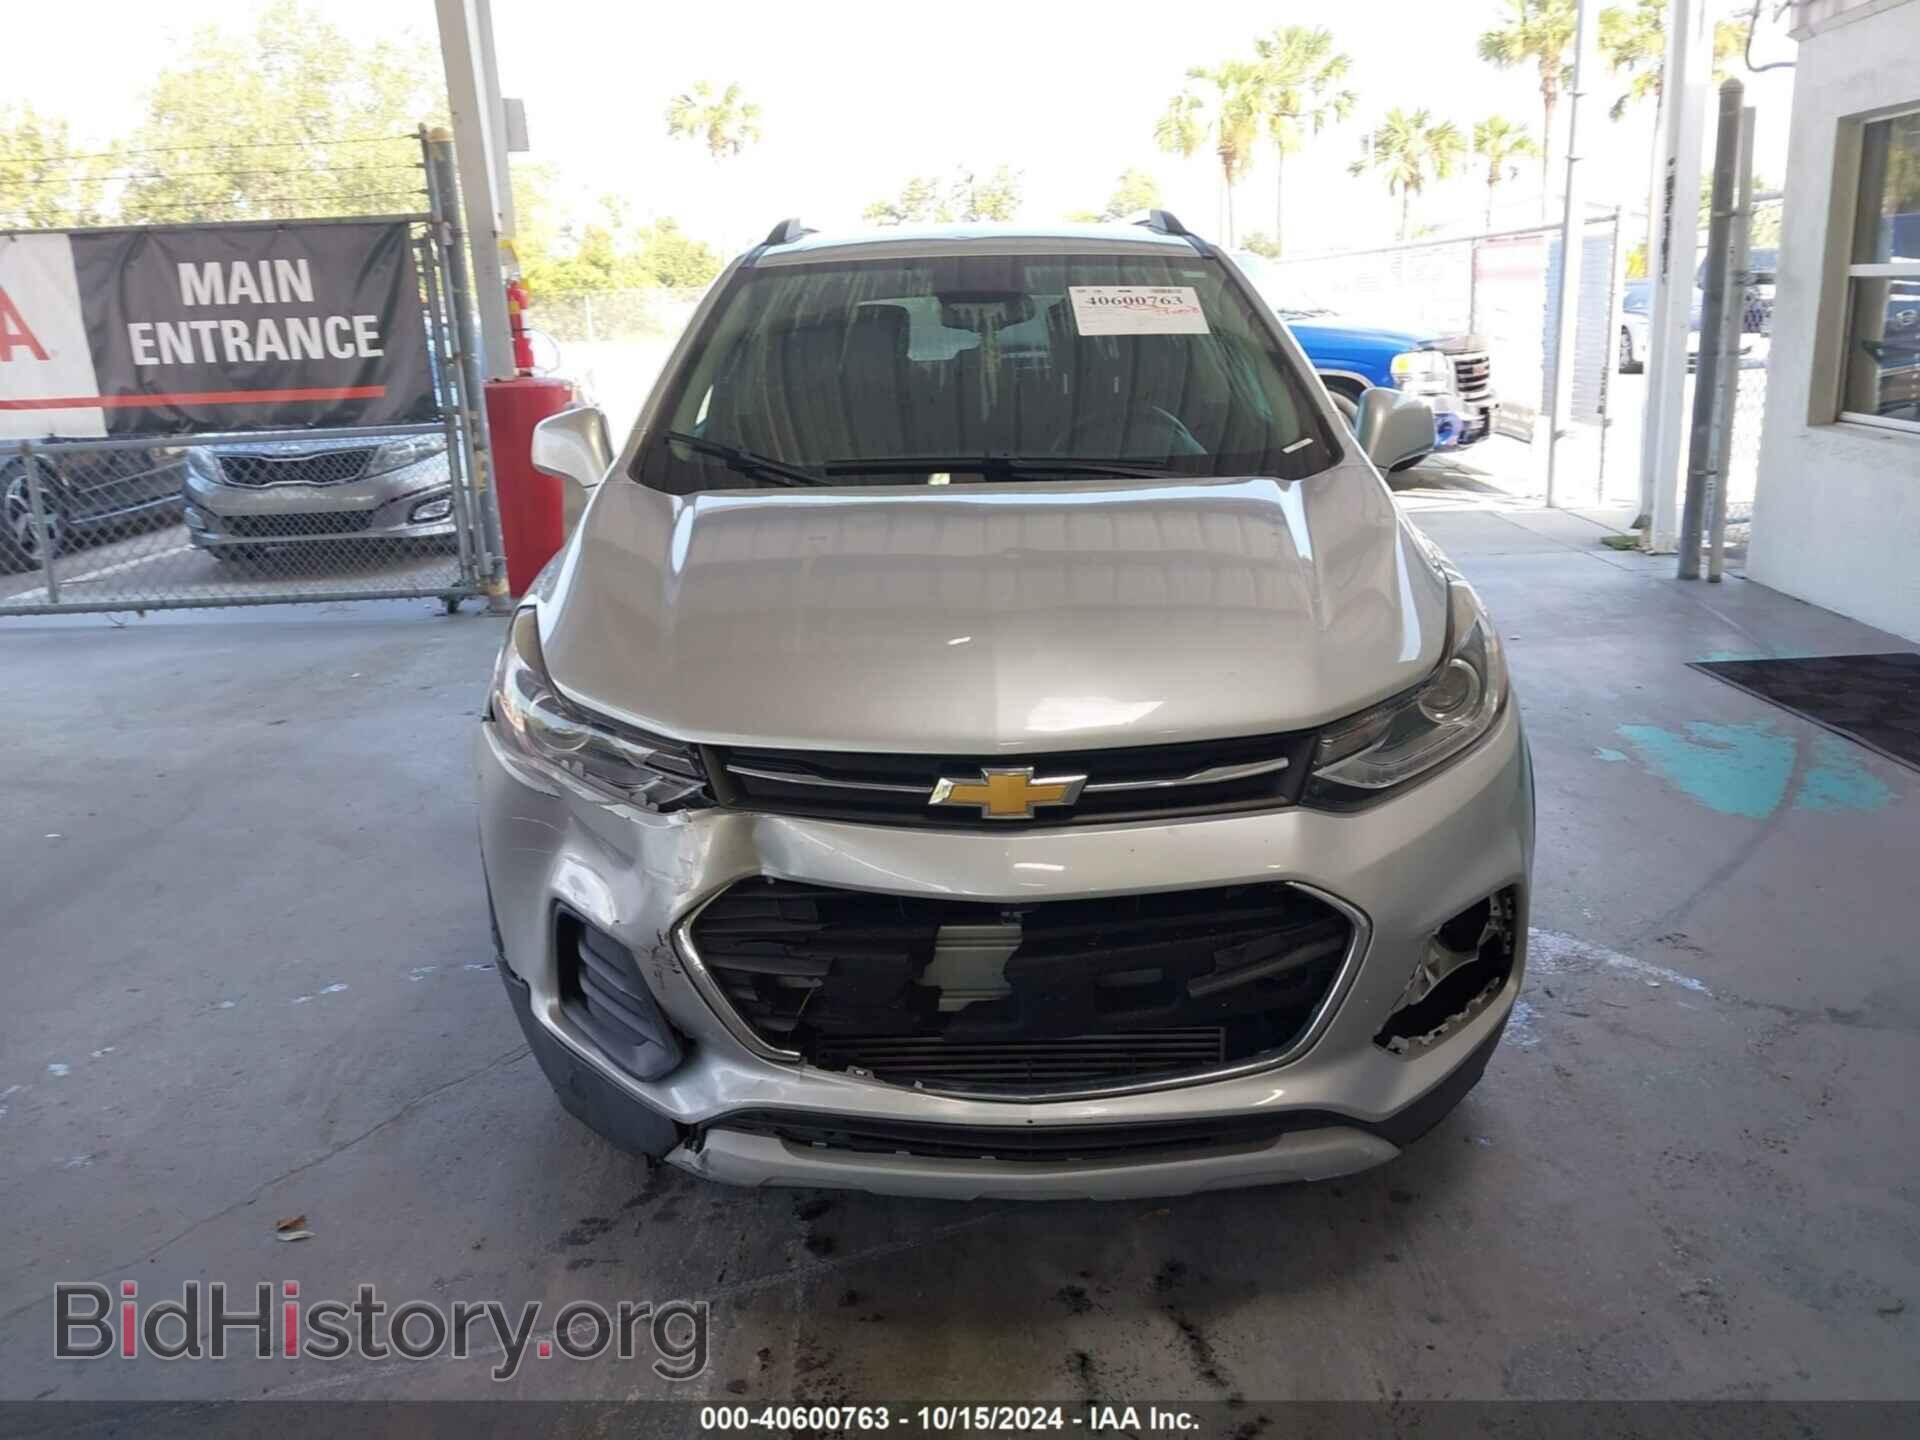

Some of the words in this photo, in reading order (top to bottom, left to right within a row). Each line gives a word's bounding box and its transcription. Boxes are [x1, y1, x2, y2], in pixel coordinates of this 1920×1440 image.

[177, 259, 315, 306] MAIN
[1085, 295, 1184, 306] 40600763
[127, 315, 384, 366] ENTRANCE
